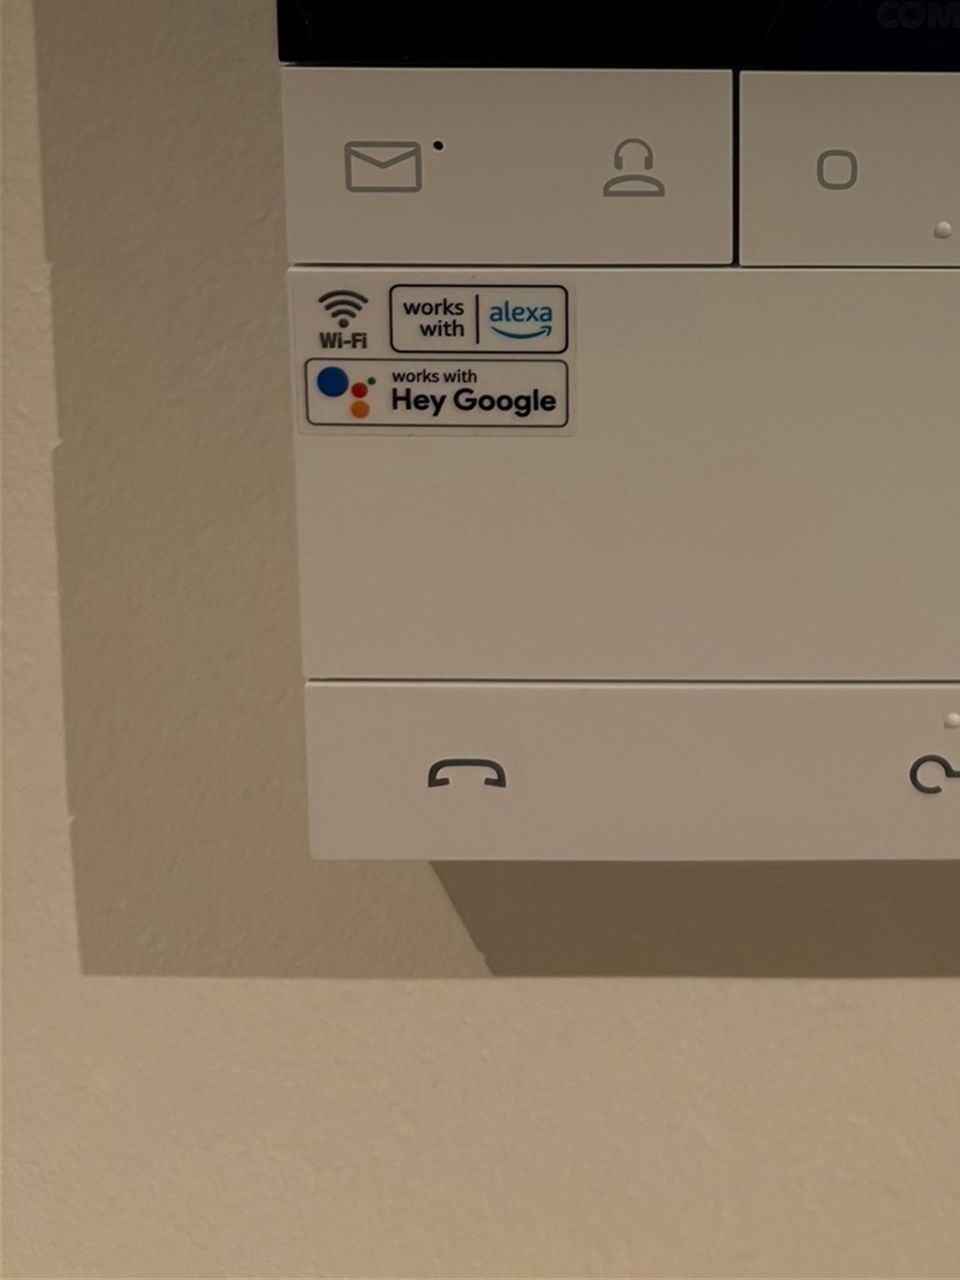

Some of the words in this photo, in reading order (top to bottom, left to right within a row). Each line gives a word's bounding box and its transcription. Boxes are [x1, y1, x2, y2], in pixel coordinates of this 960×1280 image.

[403, 298, 464, 316] works
[489, 300, 553, 322] alexa
[419, 318, 464, 337] with
[318, 332, 368, 349] Wi-Fi
[392, 369, 440, 383] works
[443, 369, 478, 383] with
[391, 388, 447, 416] Hey
[453, 388, 557, 417] Google
